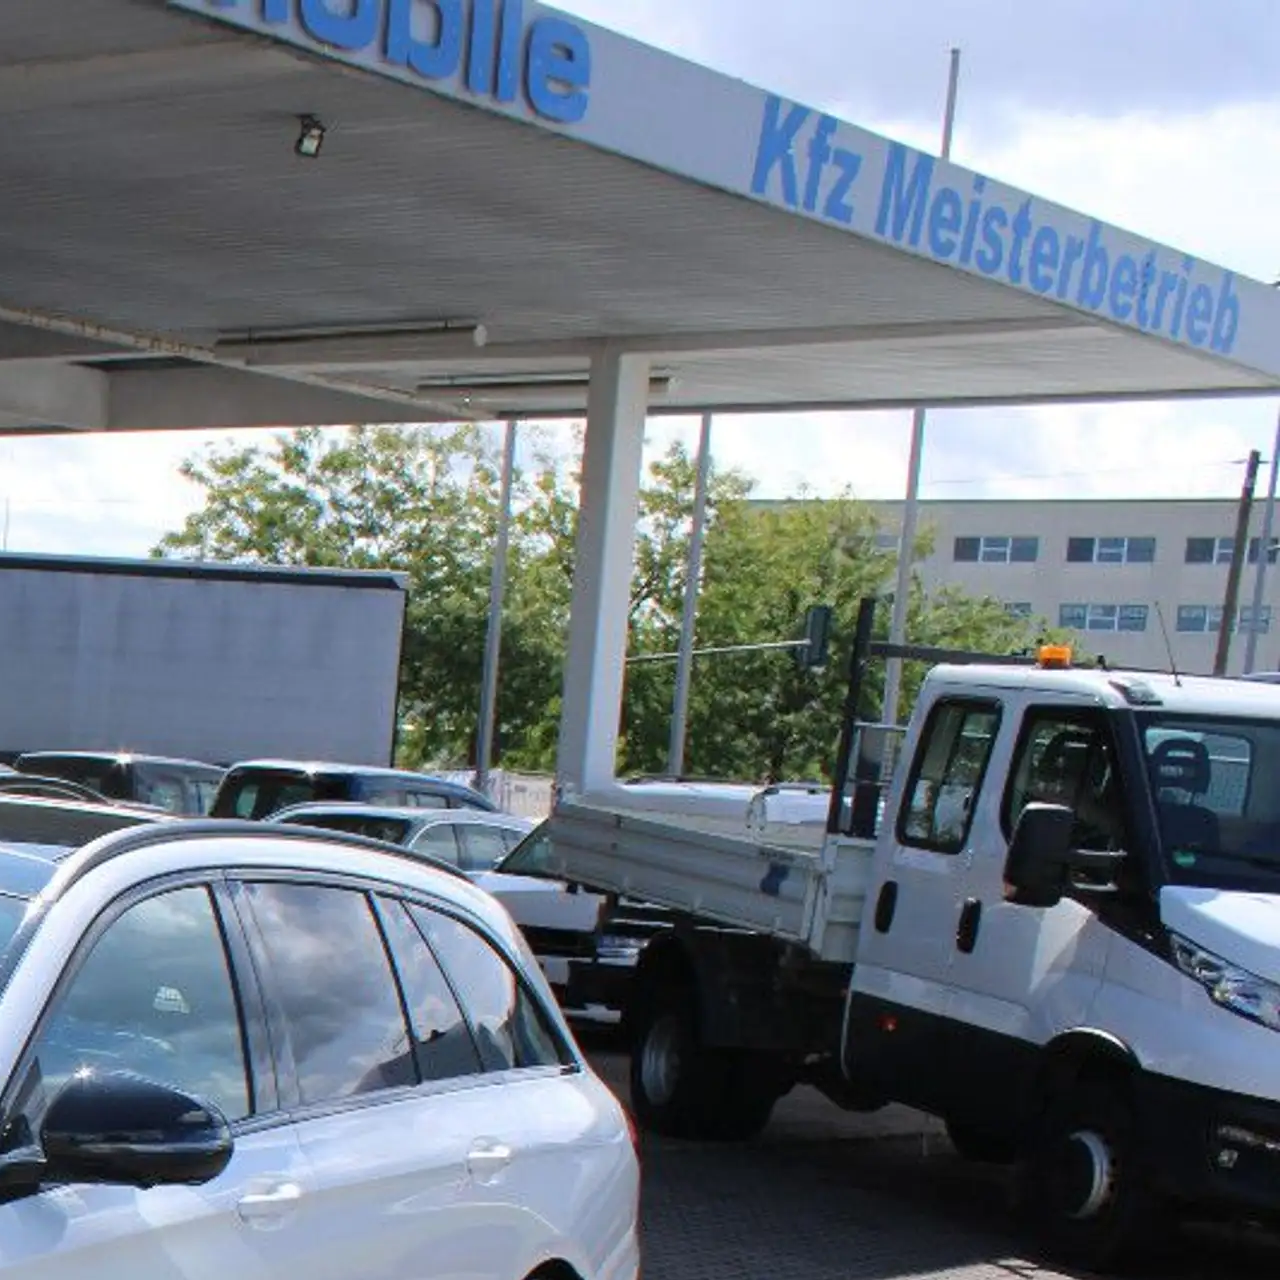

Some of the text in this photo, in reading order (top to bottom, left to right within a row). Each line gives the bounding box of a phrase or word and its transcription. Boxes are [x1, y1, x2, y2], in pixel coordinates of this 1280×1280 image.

[210, 0, 591, 124] obile
[750, 95, 1240, 354] Kfz Meisterbetrieb
